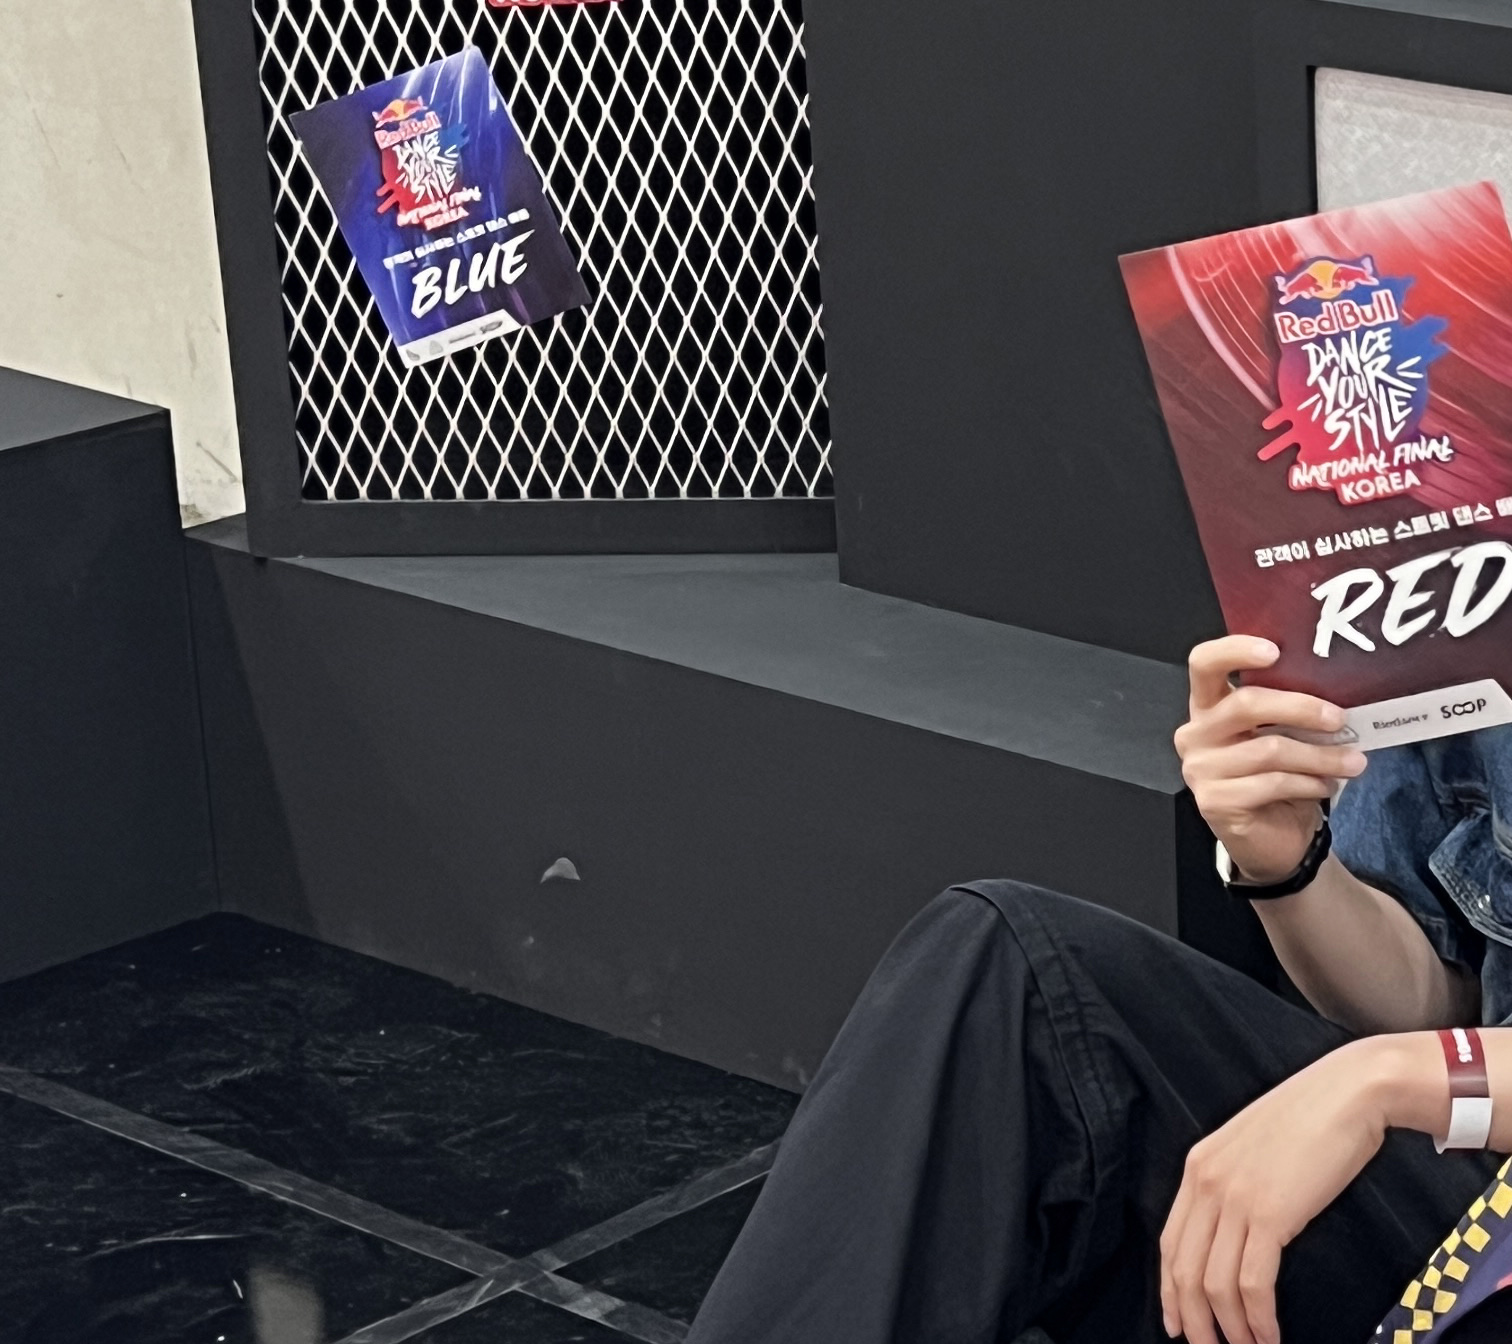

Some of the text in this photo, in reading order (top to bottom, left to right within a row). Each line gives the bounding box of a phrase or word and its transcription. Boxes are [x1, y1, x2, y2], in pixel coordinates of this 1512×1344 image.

[411, 229, 535, 319] BLUE
[1274, 289, 1398, 344] Red Bull
[1302, 327, 1392, 386] DANCE
[1321, 354, 1416, 420] YOUR
[1324, 381, 1413, 451] STYLE
[1292, 436, 1453, 488] NATIONAL FINAL
[1341, 470, 1420, 502] KOREA
